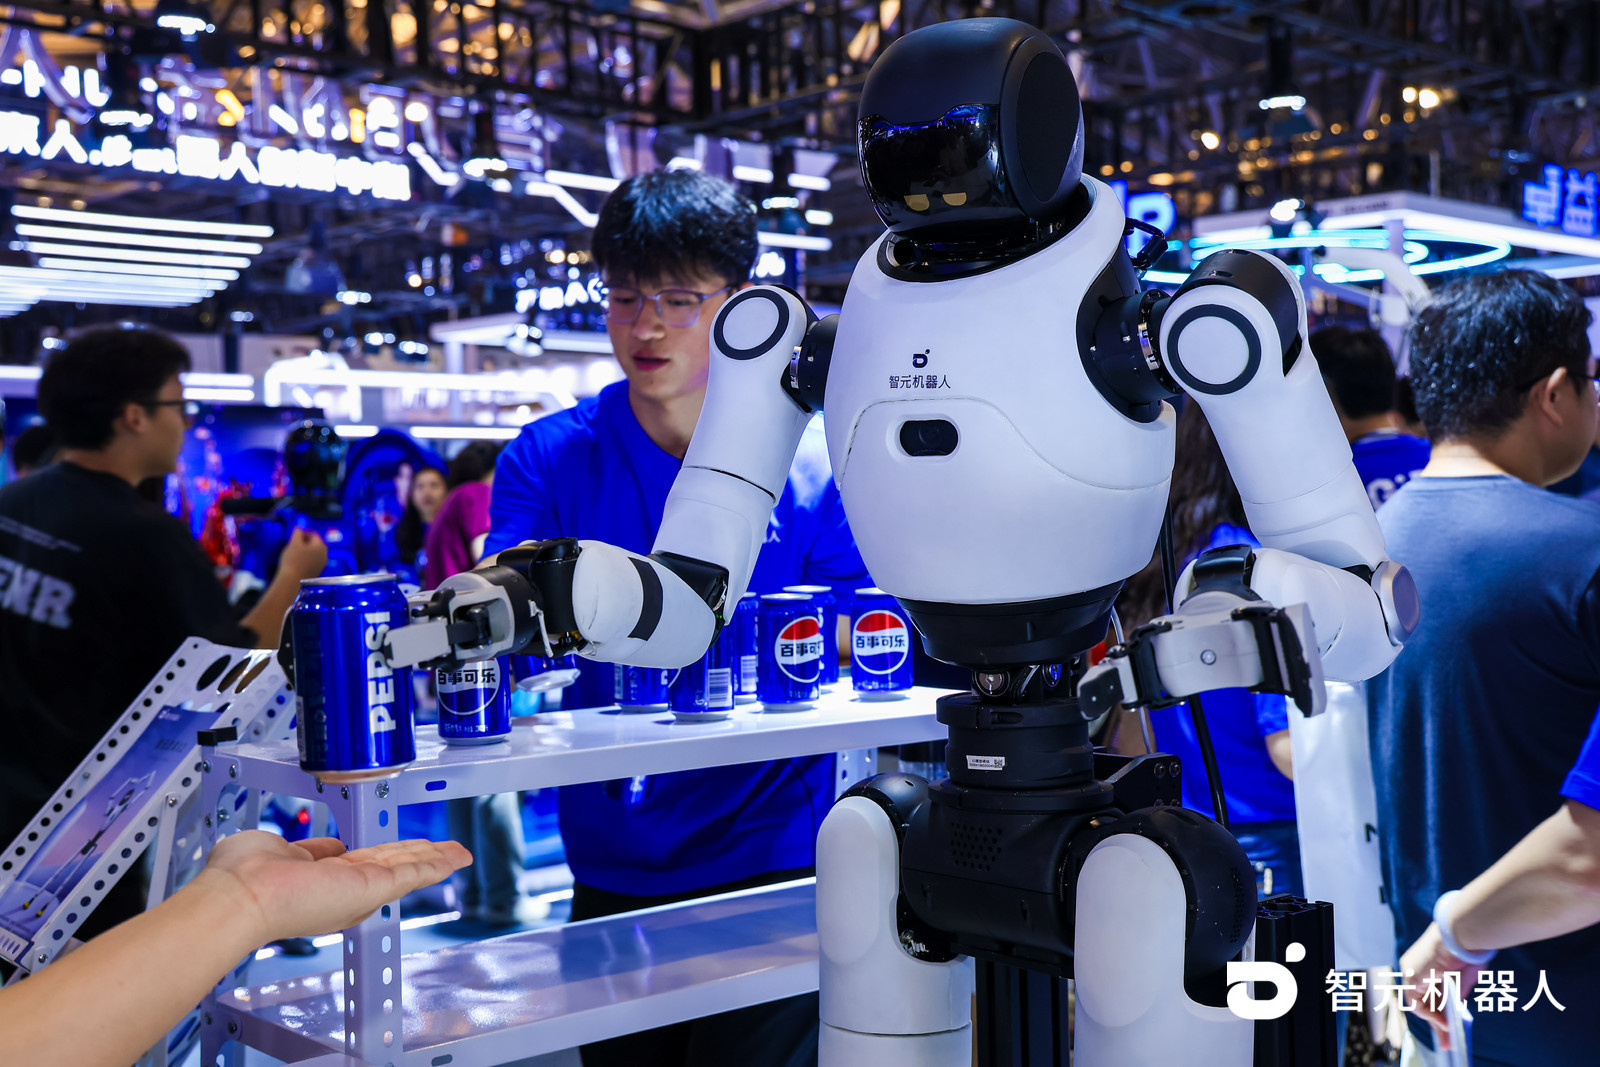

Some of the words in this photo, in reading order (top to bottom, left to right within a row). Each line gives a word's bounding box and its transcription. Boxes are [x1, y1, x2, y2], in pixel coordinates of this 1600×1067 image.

[889, 374, 951, 389] 智元机器人
[856, 635, 905, 649] 百事可乐
[364, 611, 397, 734] PEPSI
[438, 668, 496, 685] 百事可乐
